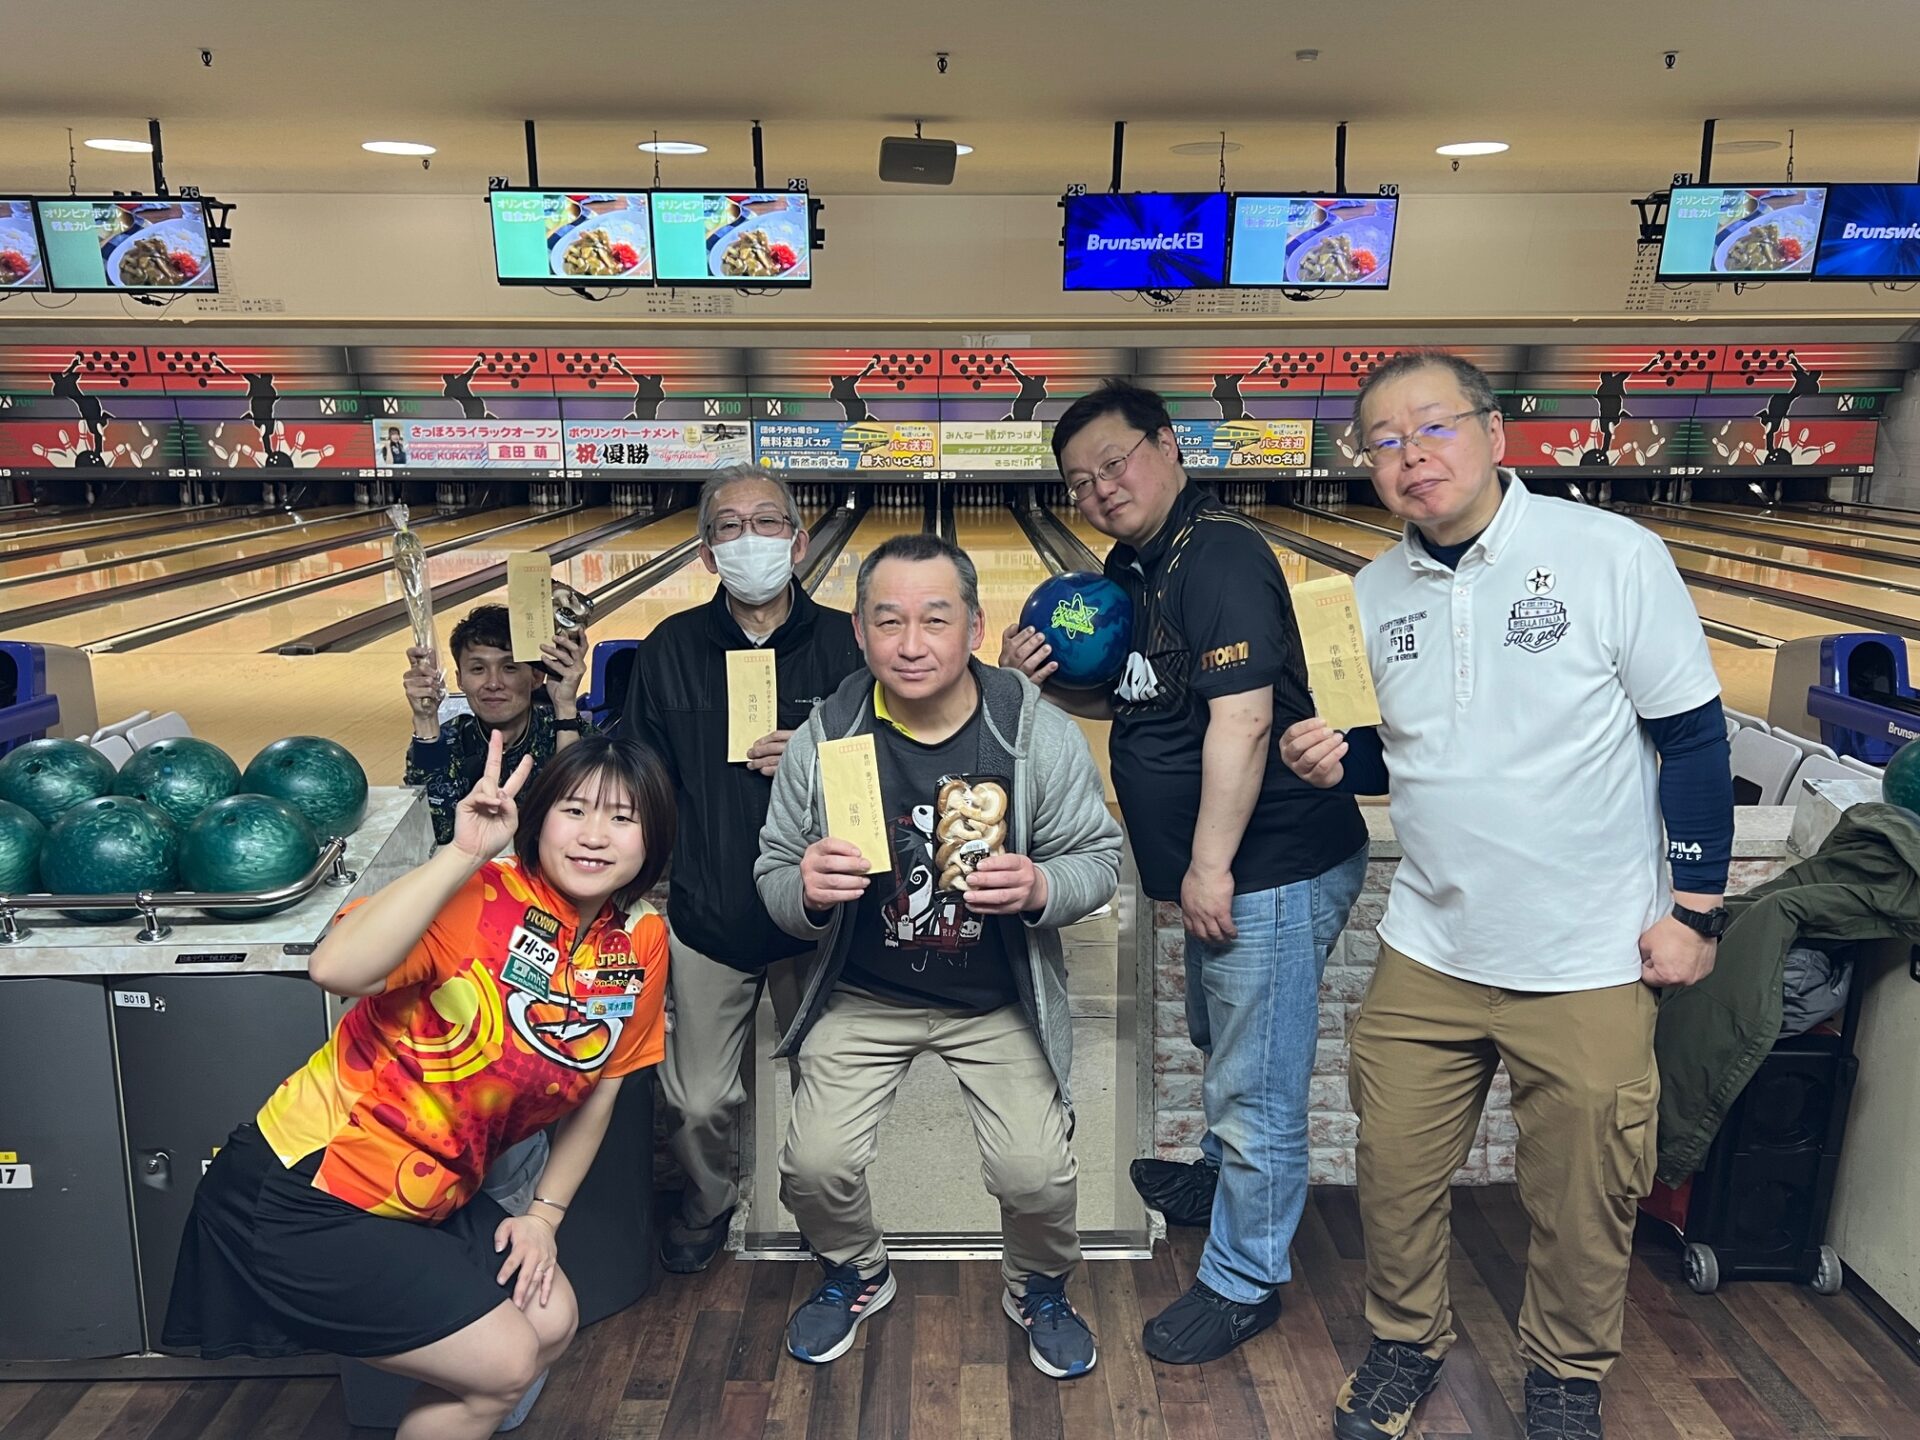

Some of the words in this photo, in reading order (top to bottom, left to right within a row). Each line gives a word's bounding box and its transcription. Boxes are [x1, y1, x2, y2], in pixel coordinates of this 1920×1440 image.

[490, 177, 507, 189] 27
[788, 178, 807, 190] 28
[1674, 173, 1690, 185] 31
[181, 186, 199, 198] 26
[1068, 184, 1086, 196] 29
[1380, 184, 1397, 196] 30
[1087, 233, 1185, 250] Brunswick
[720, 400, 741, 413] 300
[411, 426, 559, 438] さっぽろライラックオープン
[568, 427, 680, 439] ボウリングトーナメント
[760, 426, 820, 434] 団体予約の場合は
[760, 437, 831, 447] 無料送迎バスが
[889, 440, 933, 451] バス送迎
[1259, 438, 1304, 449] バス送迎
[411, 452, 433, 460] MOE
[437, 451, 483, 460] KURATA
[575, 443, 598, 464] 祝
[603, 443, 650, 464] 優勝
[1230, 454, 1306, 465] 最大140名様
[790, 457, 849, 468] 断然お得です!
[861, 456, 935, 468] 最大140名様
[169, 469, 185, 477] 20
[189, 469, 201, 477] 21
[359, 469, 375, 477] 22
[377, 469, 393, 477] 23
[548, 470, 565, 478] 24
[567, 470, 582, 478] 25
[1858, 466, 1874, 474] 38
[1380, 616, 1407, 634] EVERYTHING
[1408, 610, 1428, 624] BEGINS
[1539, 615, 1562, 626] ITALIA
[1535, 622, 1571, 646] golf
[1397, 633, 1415, 653] 18
[1201, 641, 1249, 671] STORM
[1329, 644, 1345, 680] 準優勝
[1670, 841, 1702, 853] FILA
[1670, 852, 1702, 861] GOLF
[526, 908, 558, 934] STORM
[596, 952, 639, 967] JPBA
[123, 994, 146, 1005] B018
